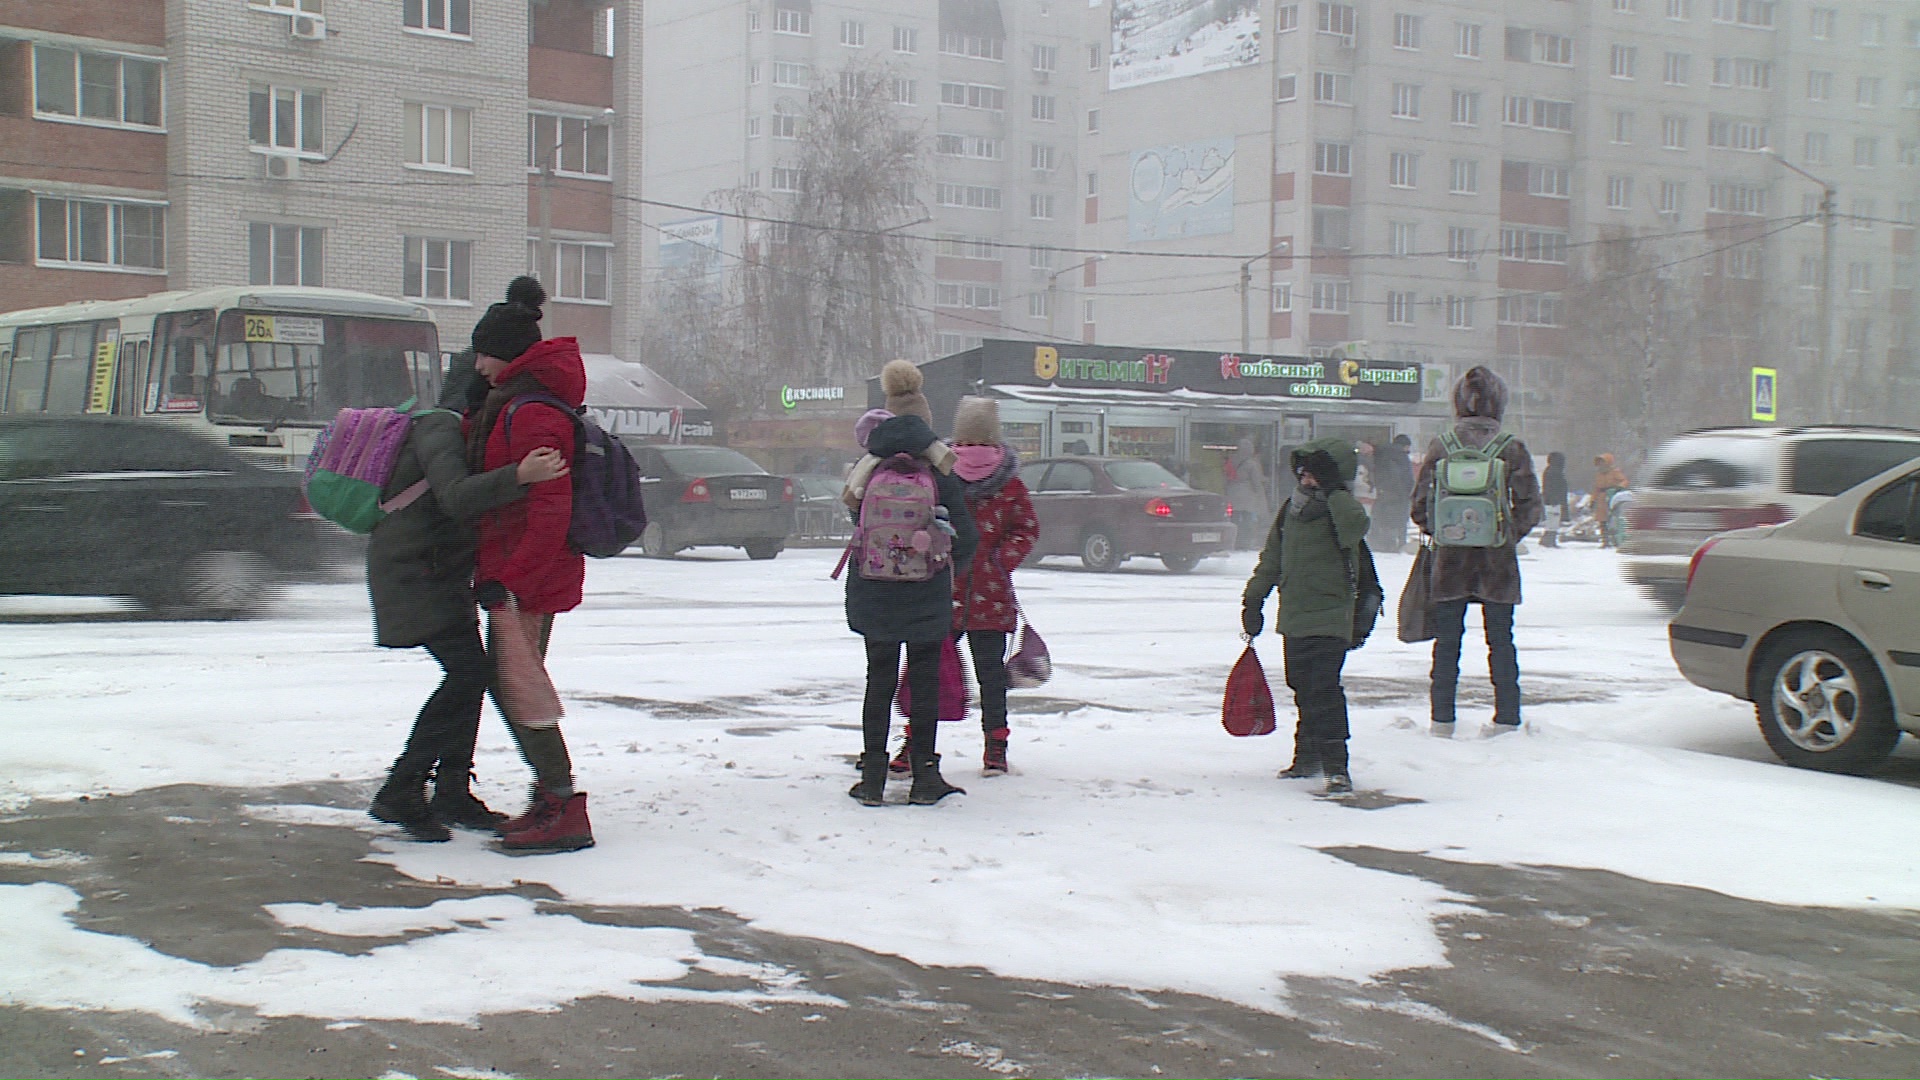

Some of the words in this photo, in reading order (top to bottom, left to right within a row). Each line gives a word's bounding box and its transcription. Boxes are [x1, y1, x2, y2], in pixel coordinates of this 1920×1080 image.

[247, 319, 273, 338] 26А
[1220, 354, 1325, 379] Колбасный
[1339, 360, 1418, 386] Сырный
[1290, 380, 1352, 397] соблазн
[586, 407, 670, 435] УШИ
